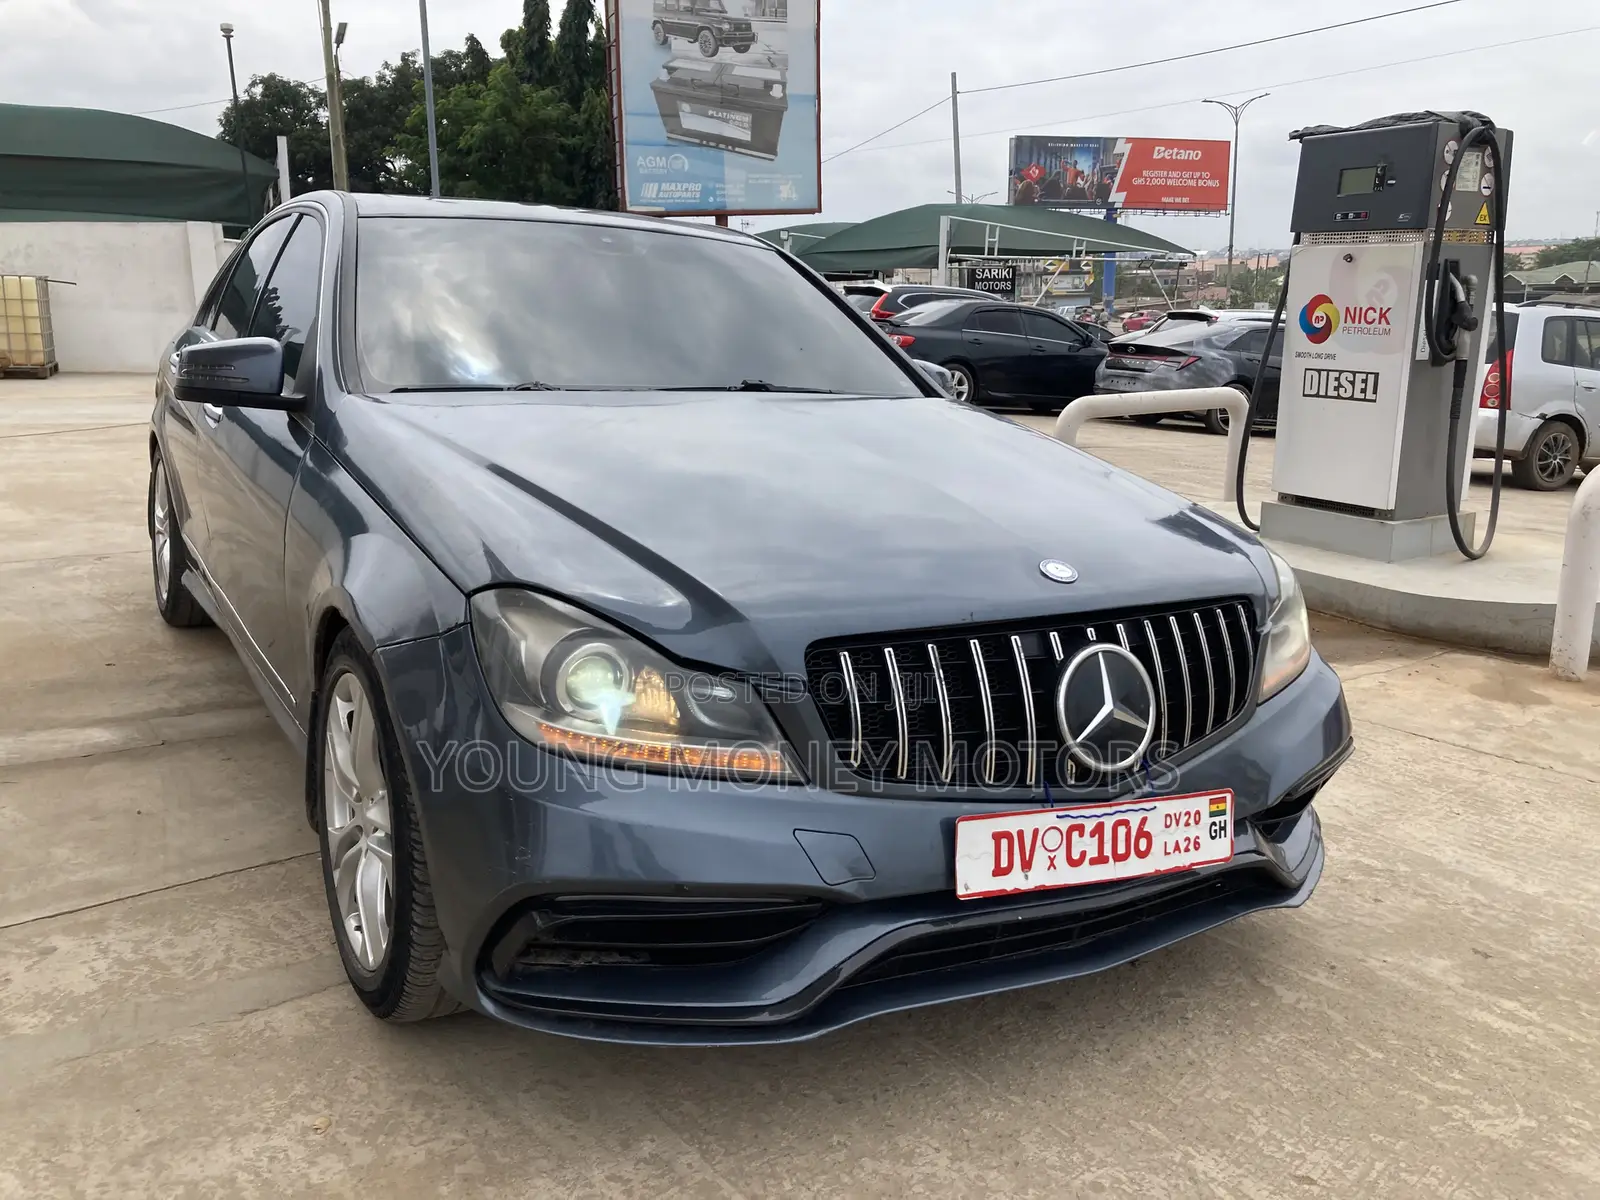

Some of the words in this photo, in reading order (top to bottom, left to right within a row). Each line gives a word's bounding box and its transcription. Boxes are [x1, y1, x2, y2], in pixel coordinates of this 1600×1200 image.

[1153, 146, 1202, 161] Betano
[637, 156, 667, 168] AGM
[1142, 170, 1167, 178] REGISTER
[1182, 171, 1192, 179] GET
[660, 182, 702, 191] MAXPRO
[1146, 178, 1166, 187] 2,000
[1166, 178, 1197, 187] WELCOME
[1198, 179, 1220, 188] BONUS
[975, 268, 1012, 279] SARIKI
[974, 281, 1012, 291] MOTORS
[1344, 306, 1393, 326] NICK
[1342, 326, 1392, 336] PETROLEUM
[1295, 351, 1311, 359] SMOOTH
[1312, 352, 1324, 360] LONG
[1324, 353, 1337, 361] DRIVE
[1304, 370, 1377, 400] DIESEL
[1163, 809, 1201, 829] DV20
[1209, 819, 1227, 841] GH
[991, 828, 1040, 878] DV
[1065, 816, 1153, 868] C106
[1163, 838, 1201, 856] LA26
